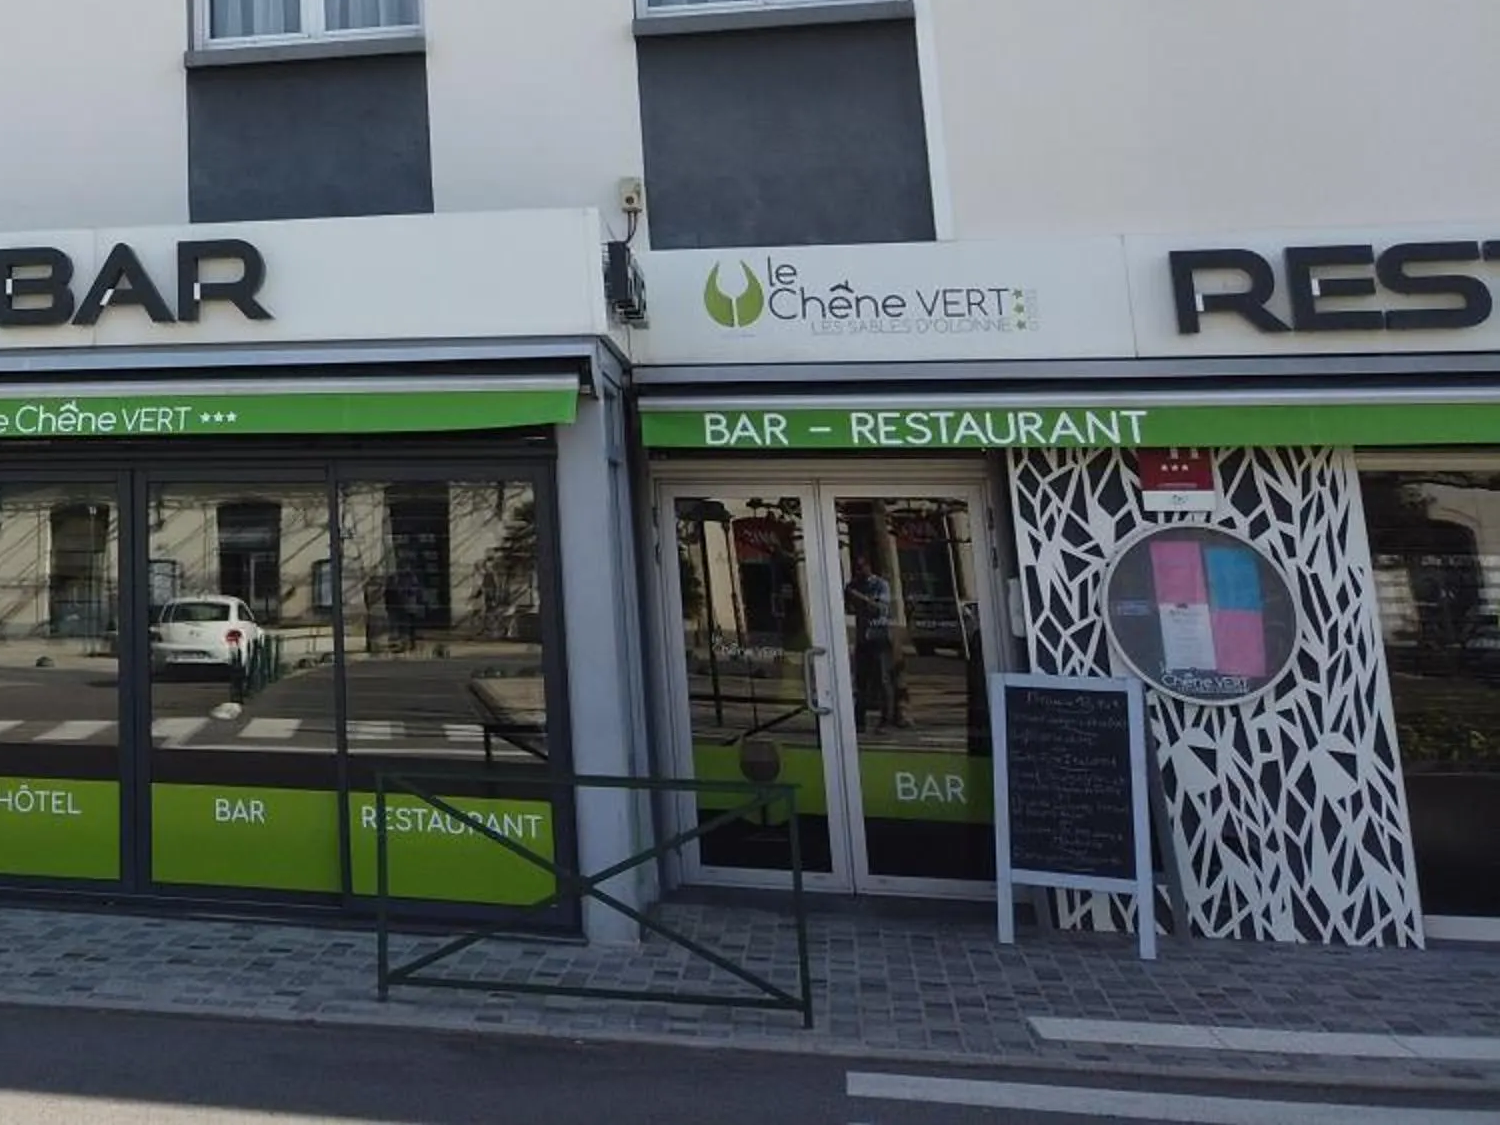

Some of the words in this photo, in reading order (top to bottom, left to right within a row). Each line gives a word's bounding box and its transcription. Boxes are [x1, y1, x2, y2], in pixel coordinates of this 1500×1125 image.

[767, 254, 798, 287] le
[768, 279, 907, 321] Chêne
[916, 287, 1009, 318] VERT
[15, 400, 117, 436] Chêne
[121, 405, 192, 433] VERT
[703, 412, 789, 446] BAR
[850, 410, 1148, 446] RESTAURANT
[895, 771, 967, 804] BAR
[214, 797, 266, 824] BAR
